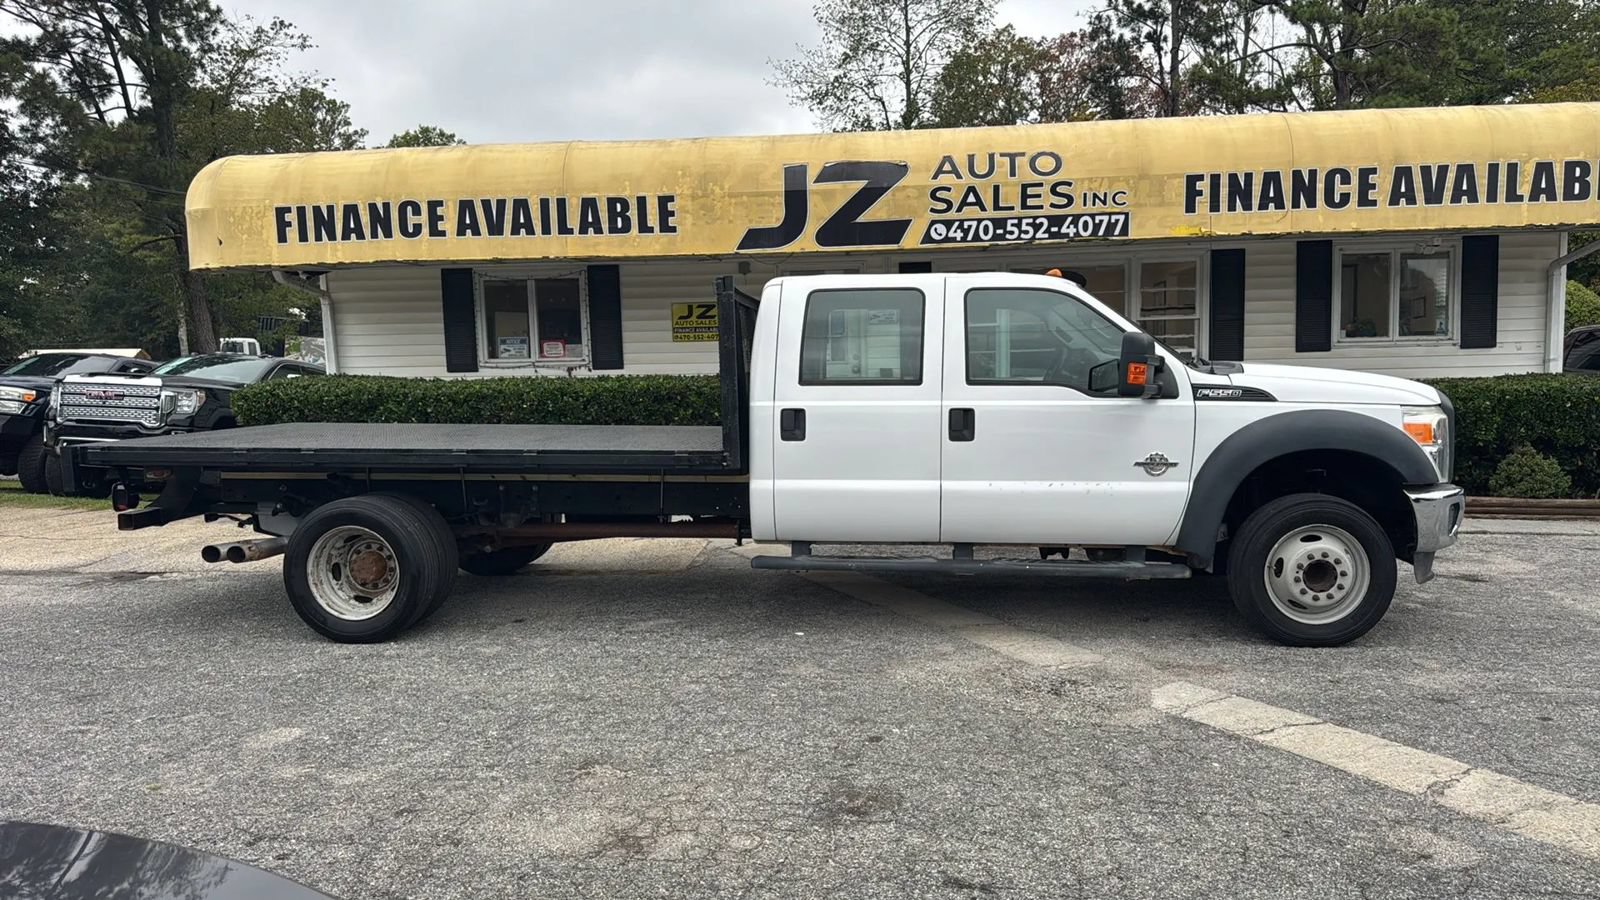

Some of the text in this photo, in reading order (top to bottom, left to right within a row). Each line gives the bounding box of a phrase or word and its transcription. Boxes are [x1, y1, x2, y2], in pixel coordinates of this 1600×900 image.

[931, 151, 1063, 180] AUTO
[929, 181, 1128, 214] SALES INC
[1184, 159, 1600, 215] FINANCE AVAILAB
[275, 194, 678, 245] FINANCE AVAILABLE
[737, 161, 910, 251] JZ
[947, 213, 1126, 242] 470-552-4077
[677, 304, 717, 320] JZ
